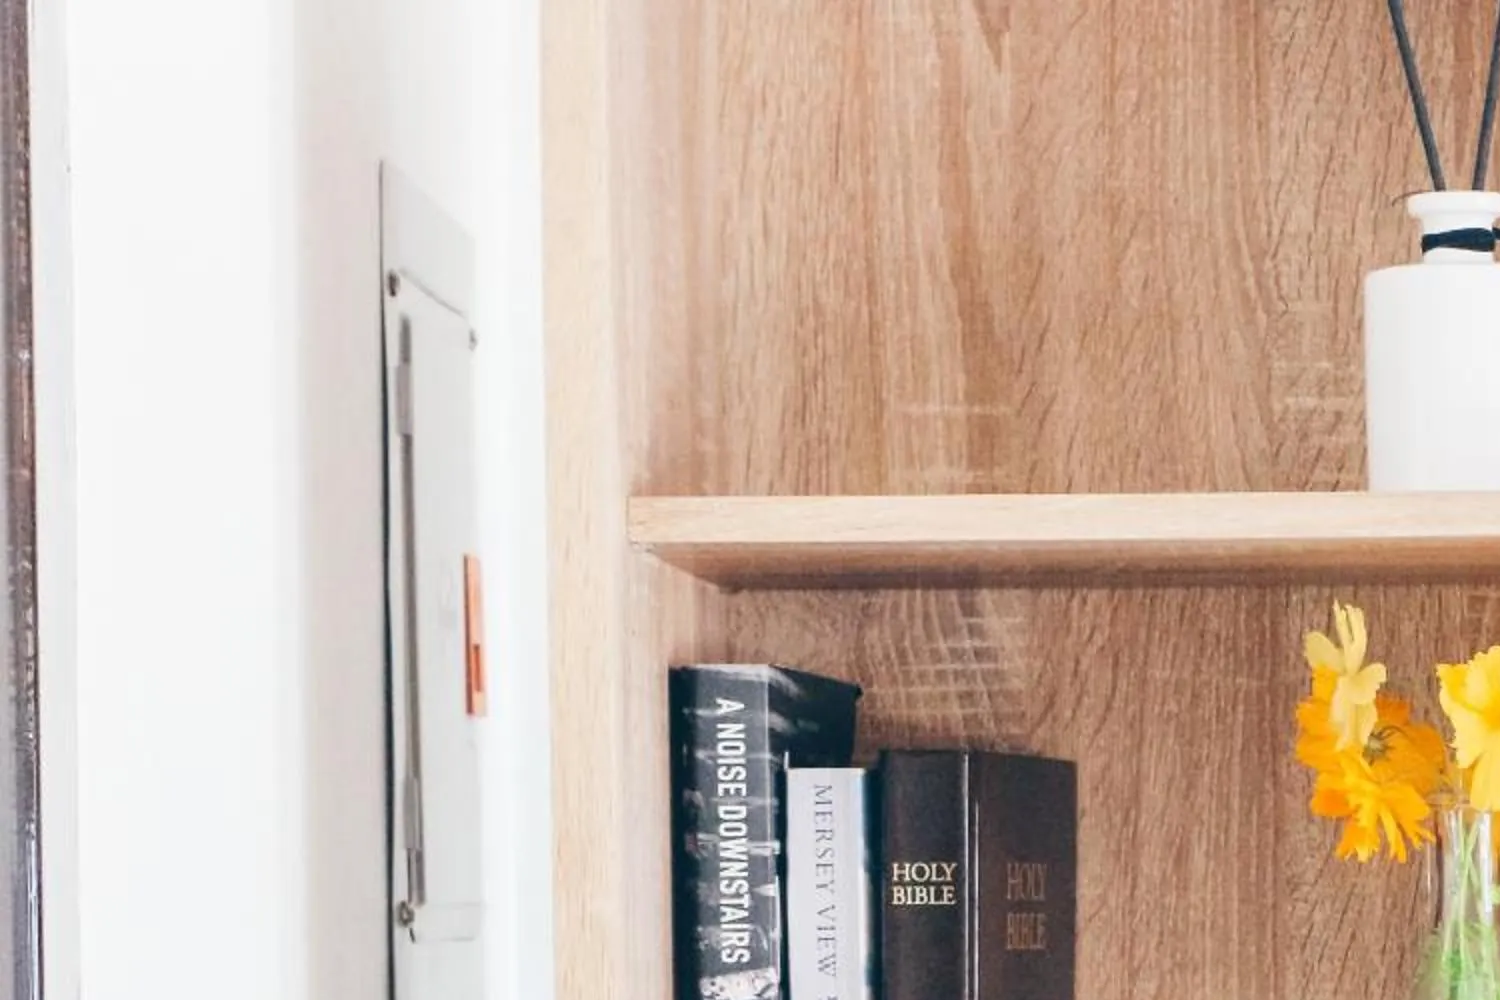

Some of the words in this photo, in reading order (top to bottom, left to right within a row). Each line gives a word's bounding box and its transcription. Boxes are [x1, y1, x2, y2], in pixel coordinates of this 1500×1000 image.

[715, 697, 745, 715] A
[716, 723, 747, 797] NOISE
[813, 784, 837, 895] MERSEY
[718, 804, 750, 964] DOWNSTAIRS
[891, 862, 958, 882] HOLY
[1006, 862, 1047, 900] HOLY
[891, 885, 957, 905] BIBLE
[816, 905, 838, 978] VIEW
[1006, 912, 1047, 950] BIBLE
